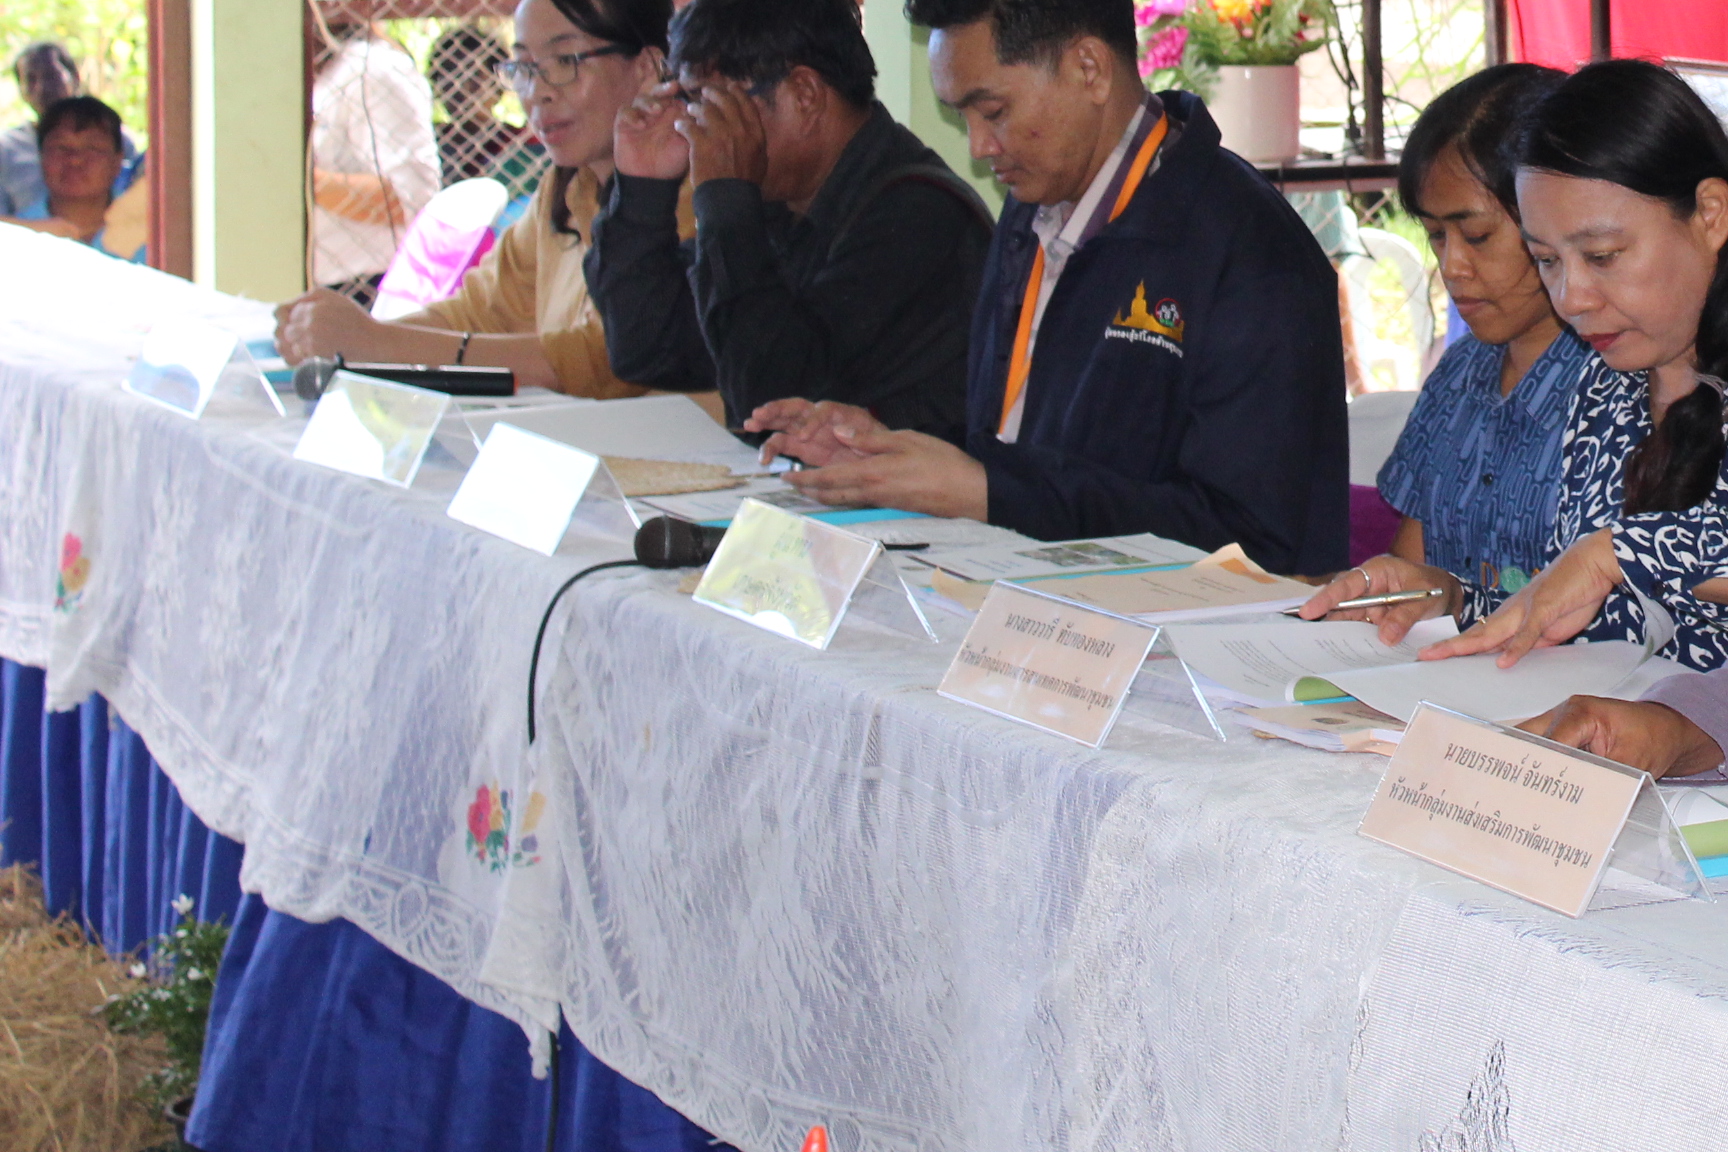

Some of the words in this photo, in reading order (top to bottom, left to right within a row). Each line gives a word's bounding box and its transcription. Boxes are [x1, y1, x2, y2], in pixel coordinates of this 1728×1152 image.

[1443, 740, 1530, 786] นายบรรพจน์
[1521, 760, 1586, 806] จันทร์งาม
[1388, 776, 1594, 869] หัวหน้ากลุ่มงานส่งเสริมการพัฒนาชุมชน
